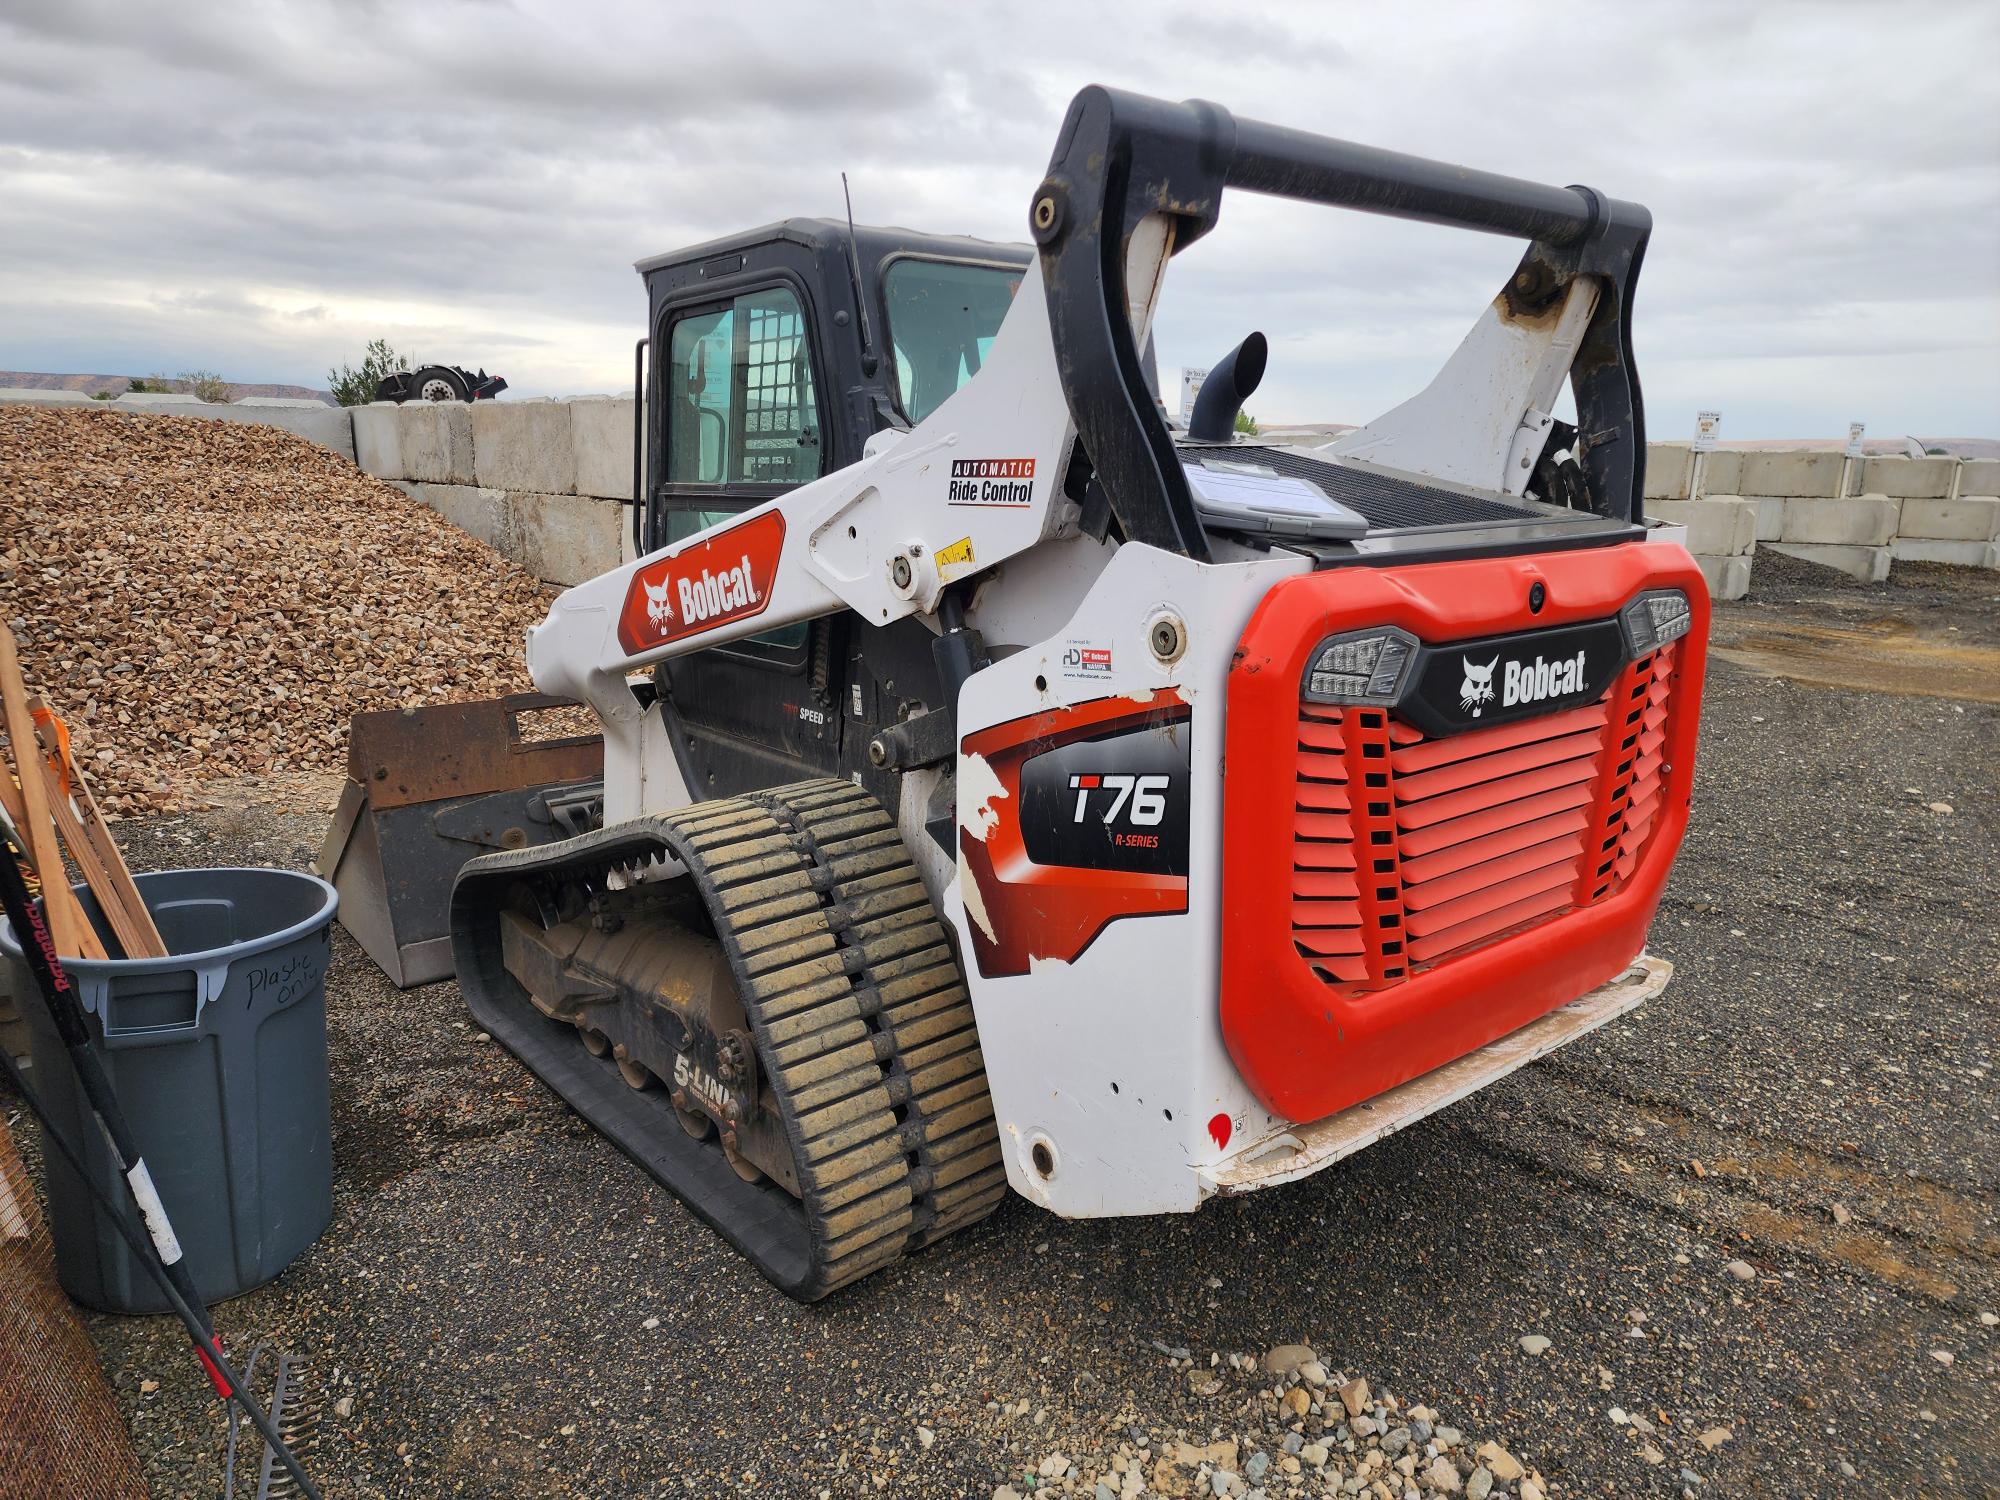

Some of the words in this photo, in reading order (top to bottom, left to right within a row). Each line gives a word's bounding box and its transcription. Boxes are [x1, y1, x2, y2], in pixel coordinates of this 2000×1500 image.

[954, 461, 1033, 476] AUTOMATIC
[948, 480, 978, 501] Ride
[981, 480, 1034, 502] Control
[677, 554, 757, 626] Bobcat
[1502, 650, 1585, 708] Bobcat
[799, 707, 824, 725] SPEED
[1069, 775, 1170, 826] T76
[1115, 834, 1159, 849] R-SERIES
[246, 955, 312, 1011] Plastic
